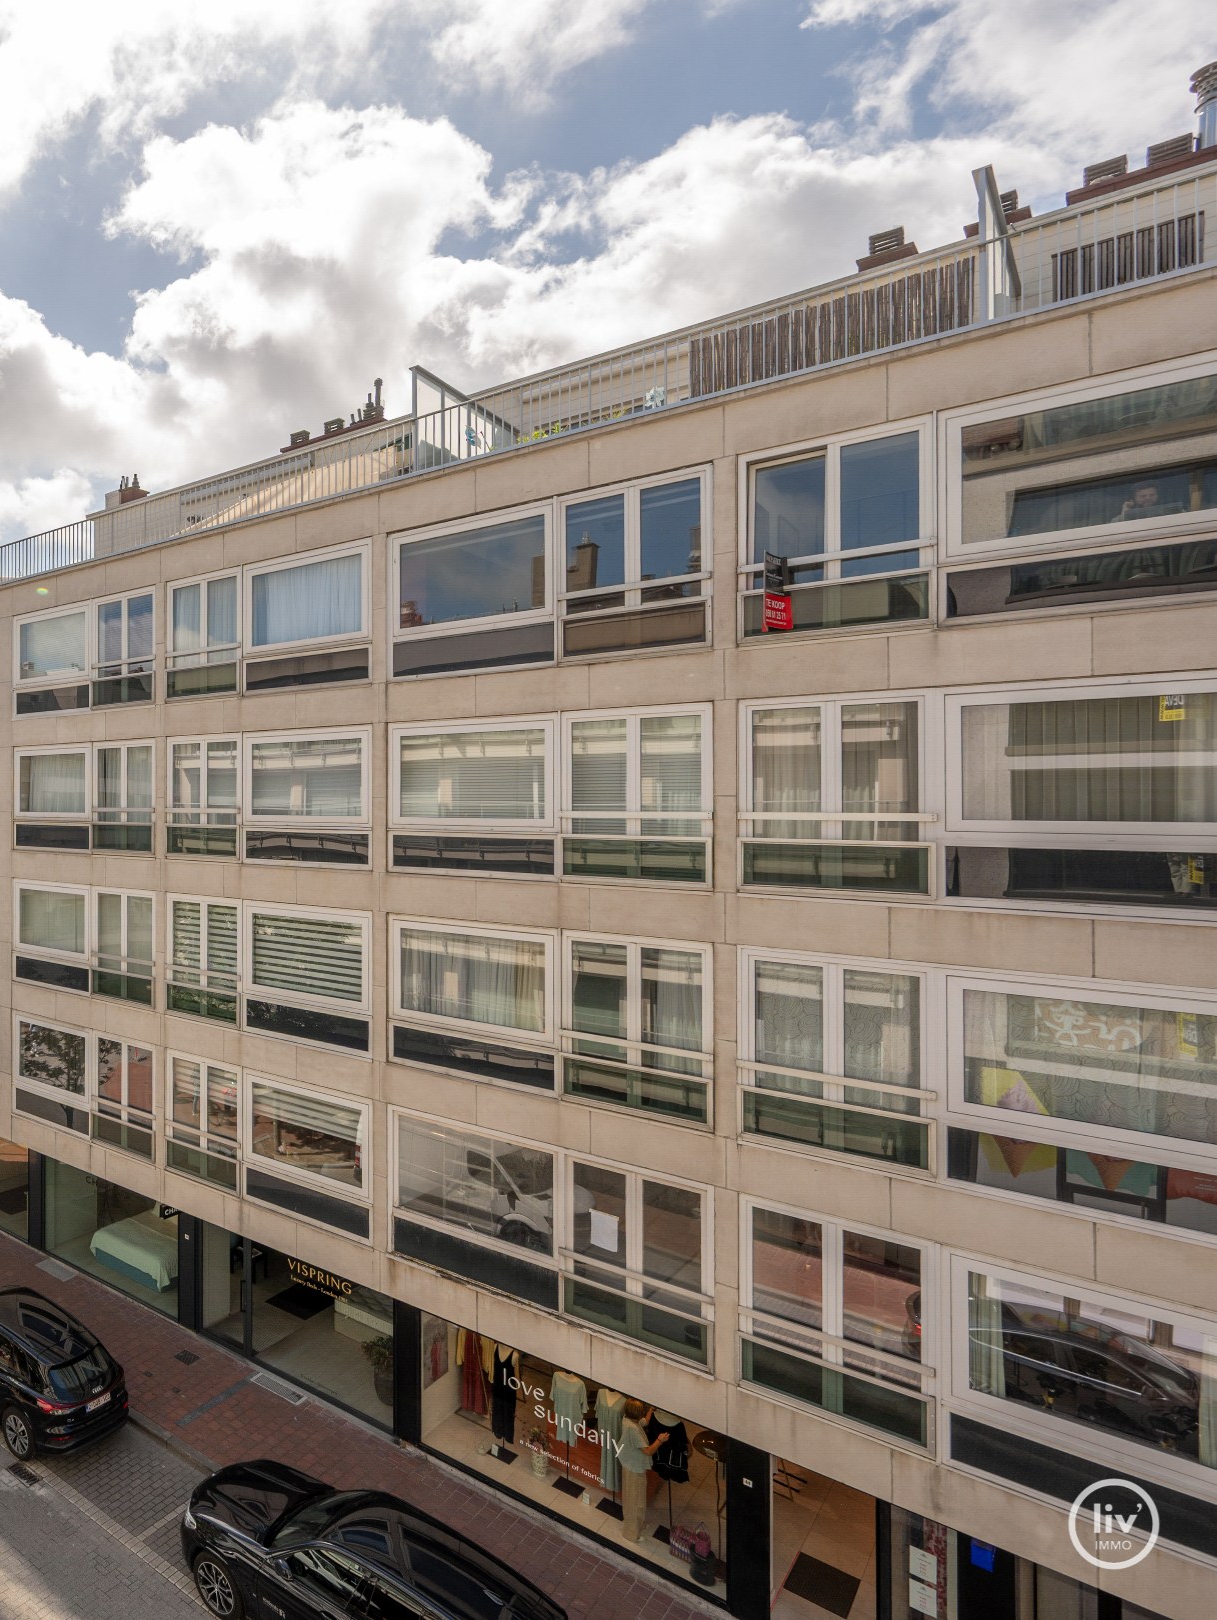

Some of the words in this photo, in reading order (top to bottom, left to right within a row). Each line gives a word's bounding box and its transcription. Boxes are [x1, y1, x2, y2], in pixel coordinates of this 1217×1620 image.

[765, 598, 771, 607] TE
[772, 600, 785, 610] KOOP
[287, 1258, 352, 1294] VISPRING
[503, 1367, 545, 1401] love
[533, 1403, 625, 1458] sundaily
[525, 1441, 538, 1452] new
[539, 1448, 570, 1468] selection
[571, 1462, 580, 1472] of
[580, 1467, 605, 1485] fabrics
